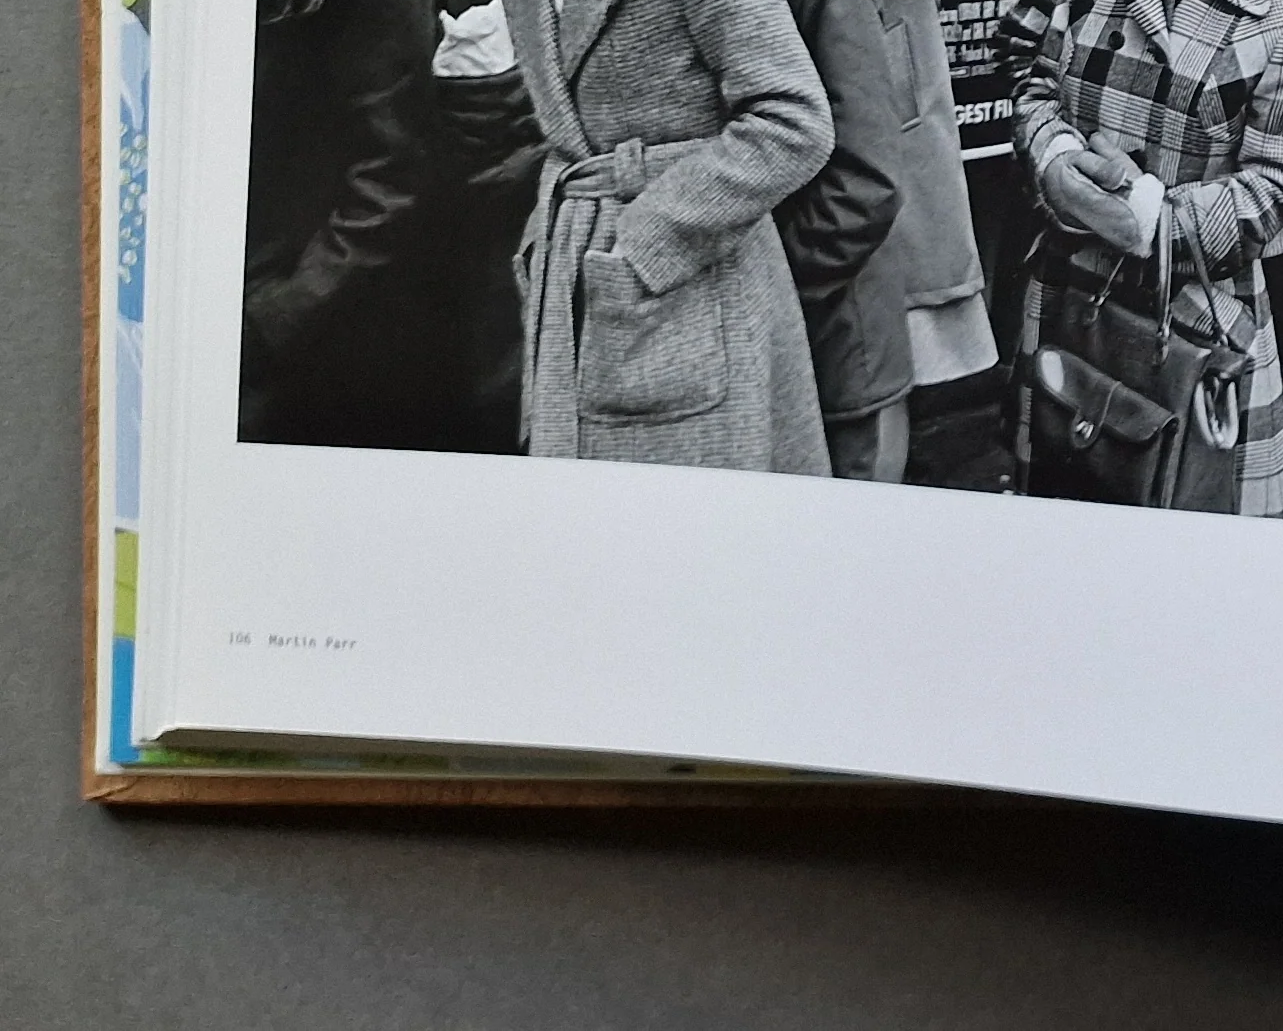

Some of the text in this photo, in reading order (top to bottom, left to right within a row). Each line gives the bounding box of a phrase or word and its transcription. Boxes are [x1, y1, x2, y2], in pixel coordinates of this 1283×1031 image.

[229, 632, 357, 649] 106 Martin Parr
